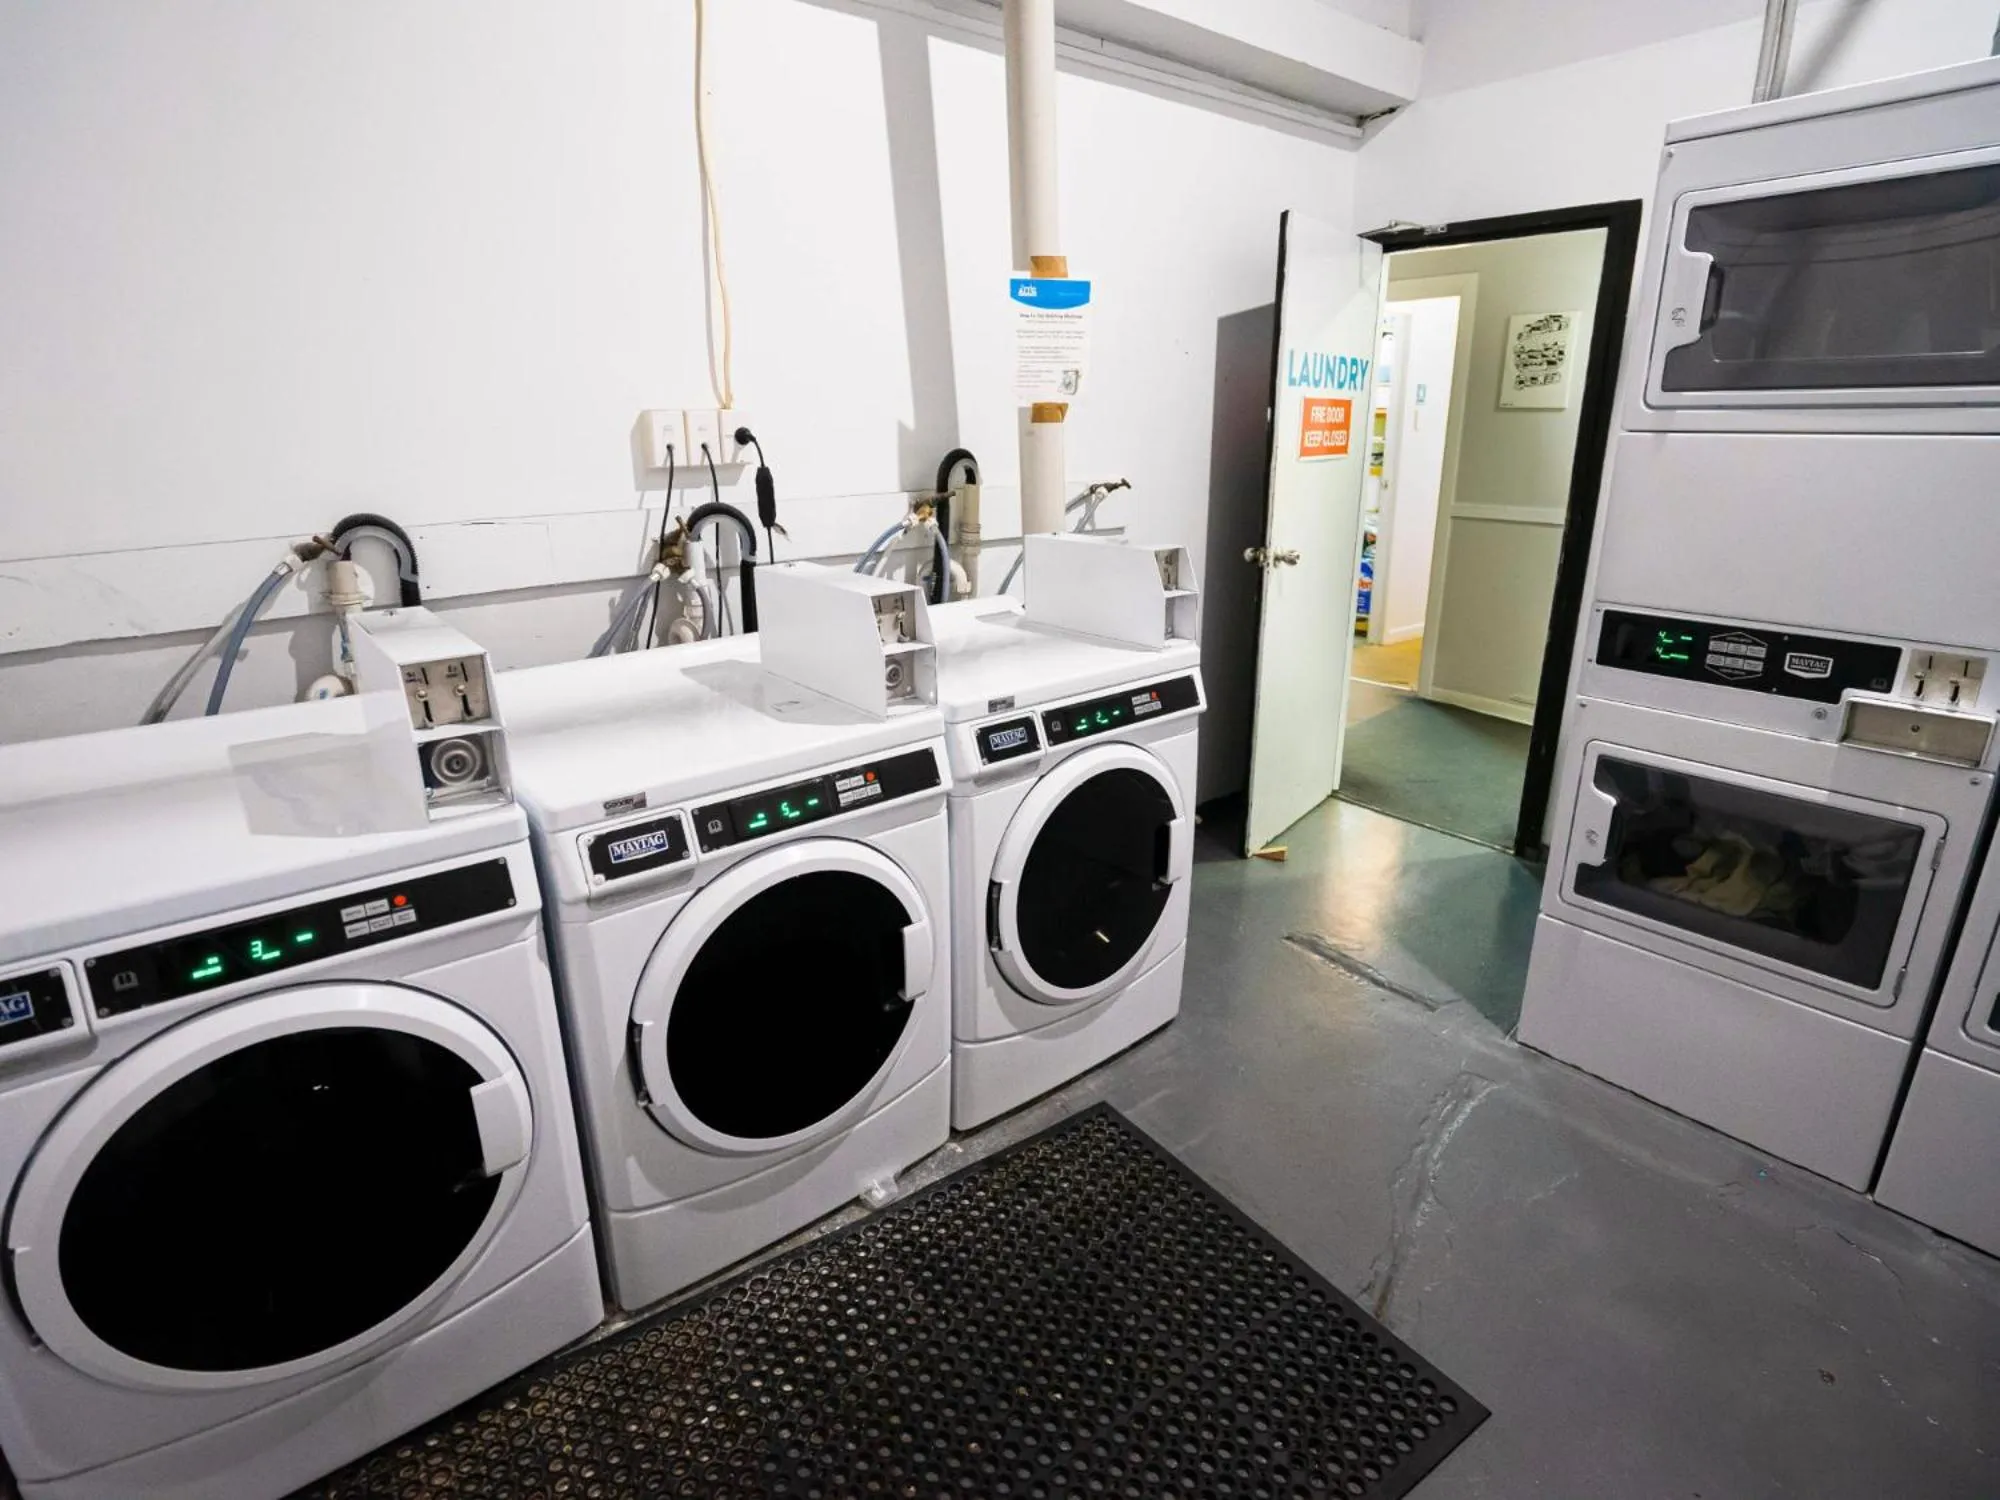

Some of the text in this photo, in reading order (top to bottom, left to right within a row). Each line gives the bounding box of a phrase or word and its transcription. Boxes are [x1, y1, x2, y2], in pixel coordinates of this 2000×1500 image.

[1287, 347, 1369, 391] LAUNDRY
[1311, 406, 1345, 423] FIRE DOOR
[1304, 430, 1348, 448] KEEP CLOSED
[1791, 657, 1828, 669] MAYTAG
[992, 729, 1025, 745] MAYTAG
[612, 834, 664, 856] MAYTAG
